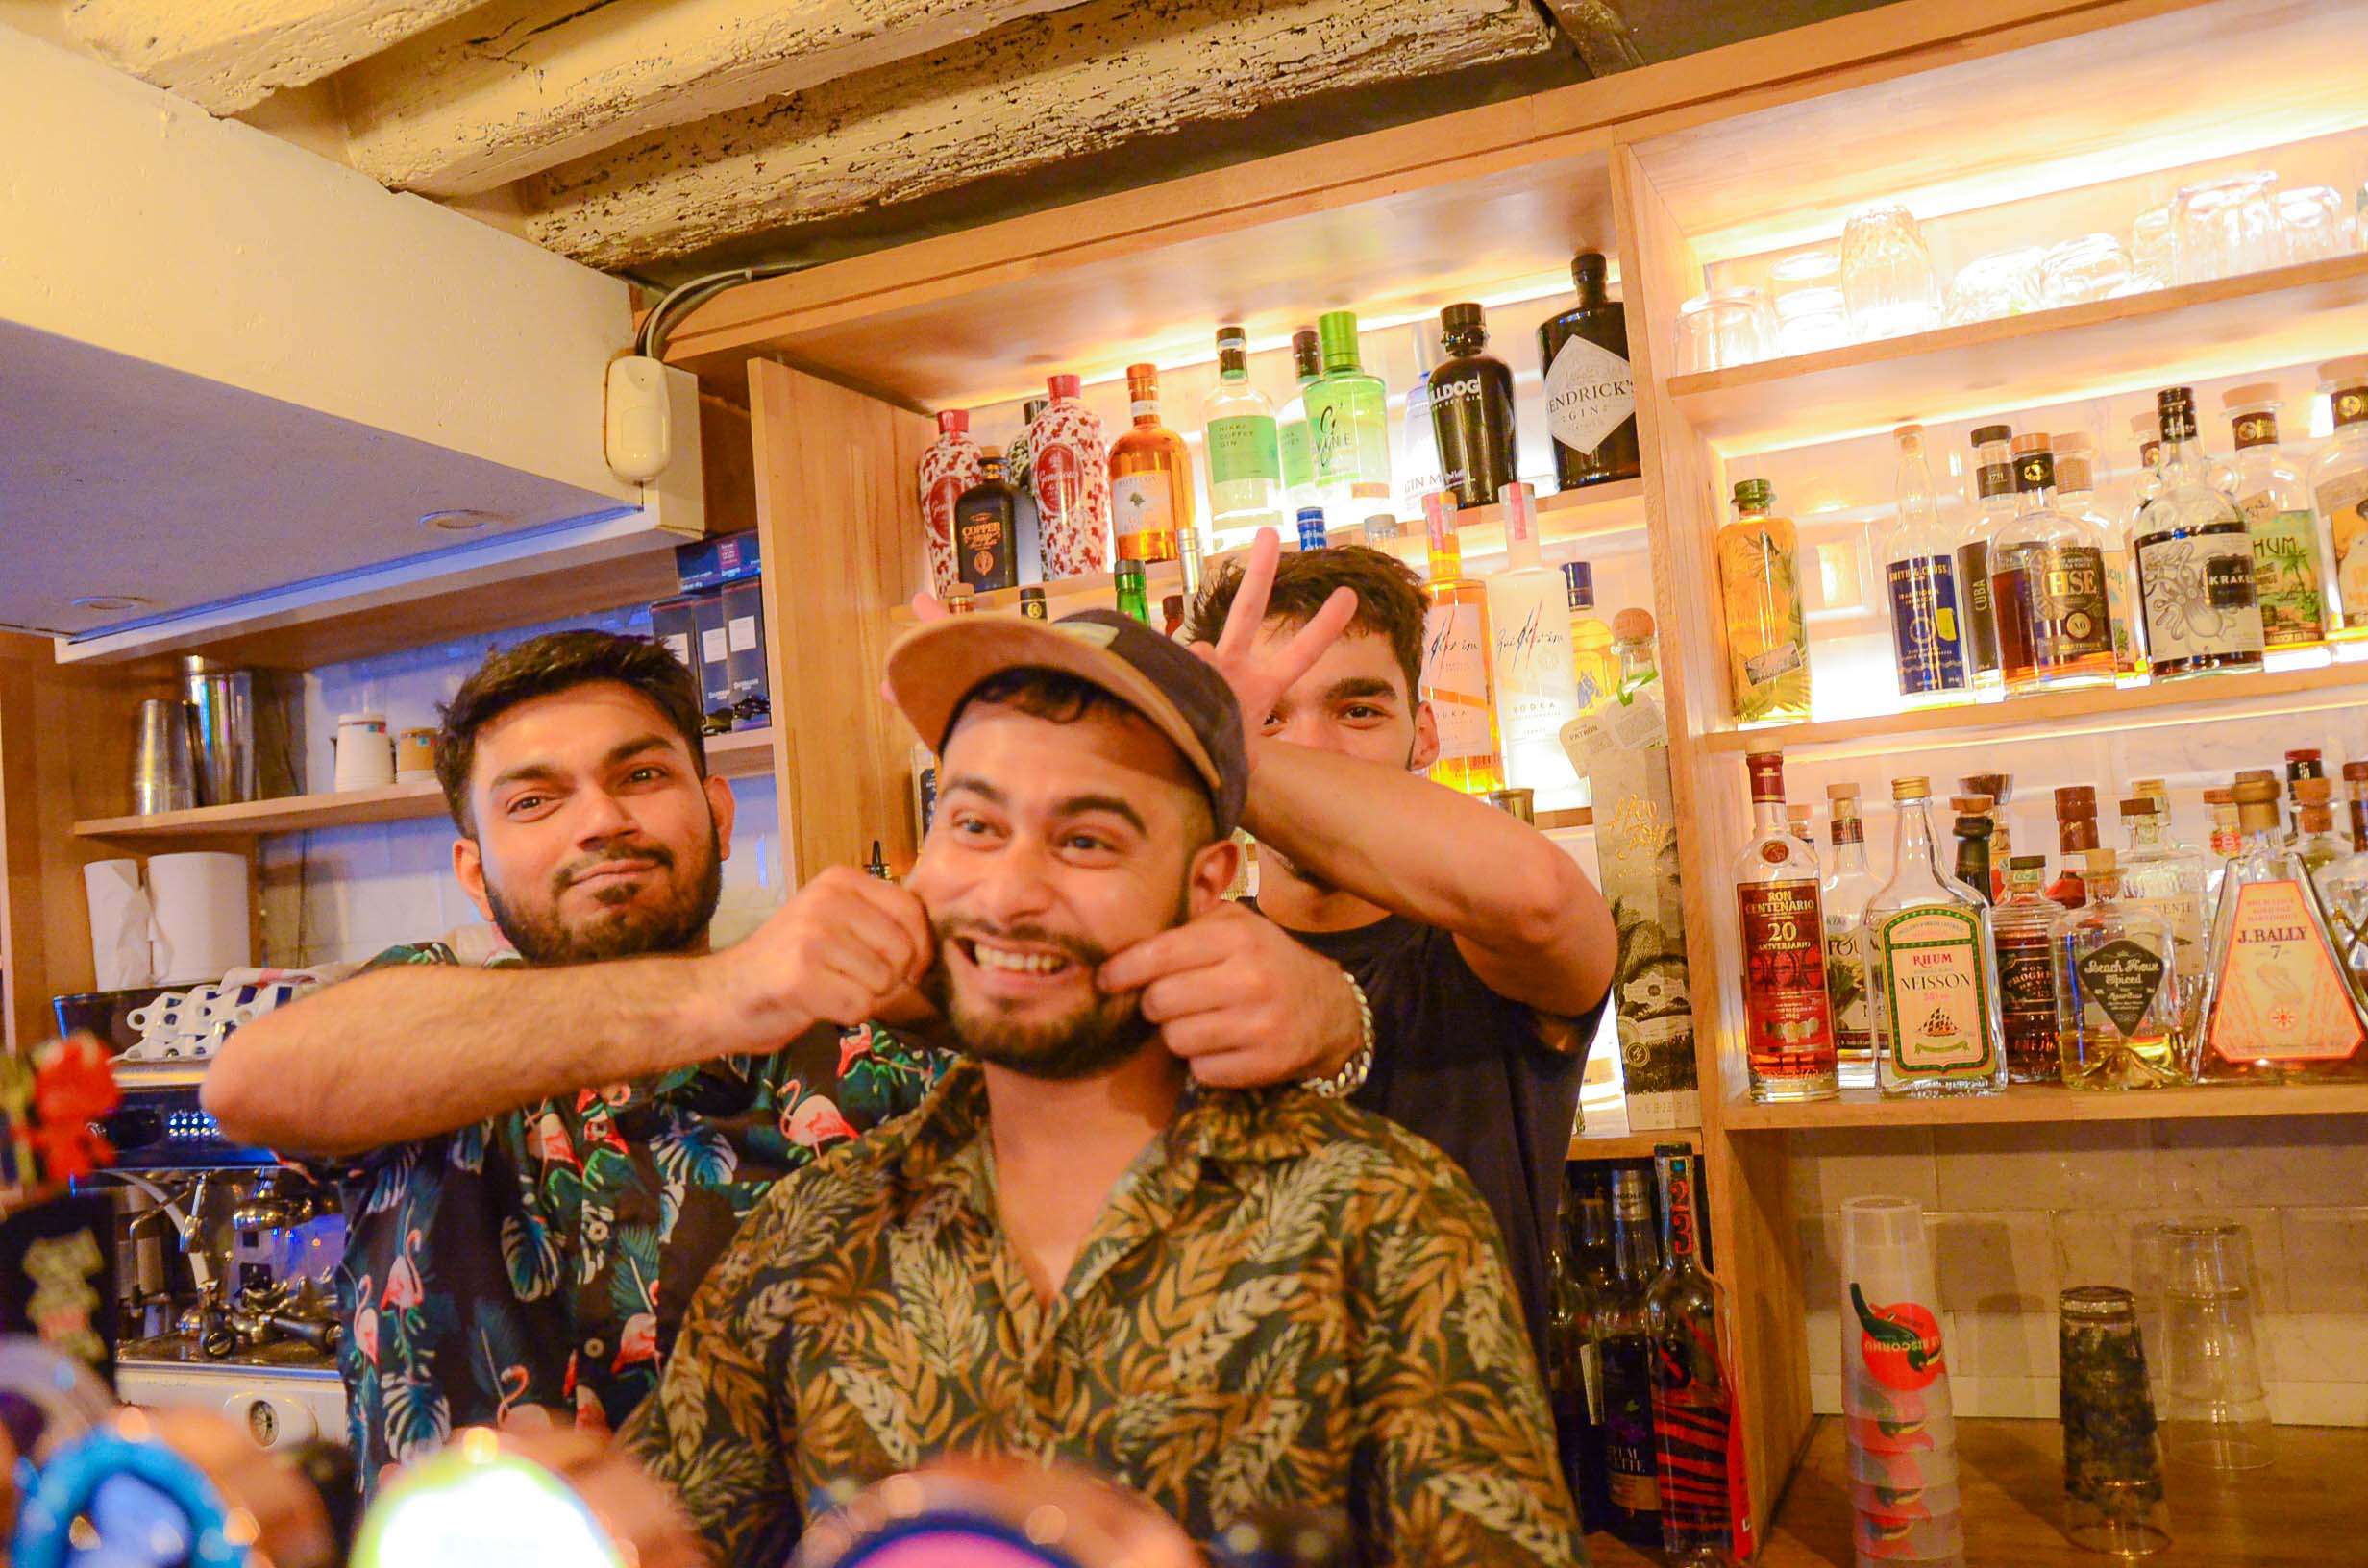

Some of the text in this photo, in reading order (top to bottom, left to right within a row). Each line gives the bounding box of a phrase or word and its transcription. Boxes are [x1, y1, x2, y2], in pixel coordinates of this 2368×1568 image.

[1546, 380, 1634, 417] ENDRICK'
[2252, 537, 2298, 557] HUM
[2208, 574, 2254, 586] KRAKE
[1767, 891, 1793, 902] RON
[1767, 921, 1798, 942] 20
[1912, 953, 1953, 969] RHUM
[1900, 973, 1972, 992] NEISSON
[2105, 973, 2143, 989] Spiced
